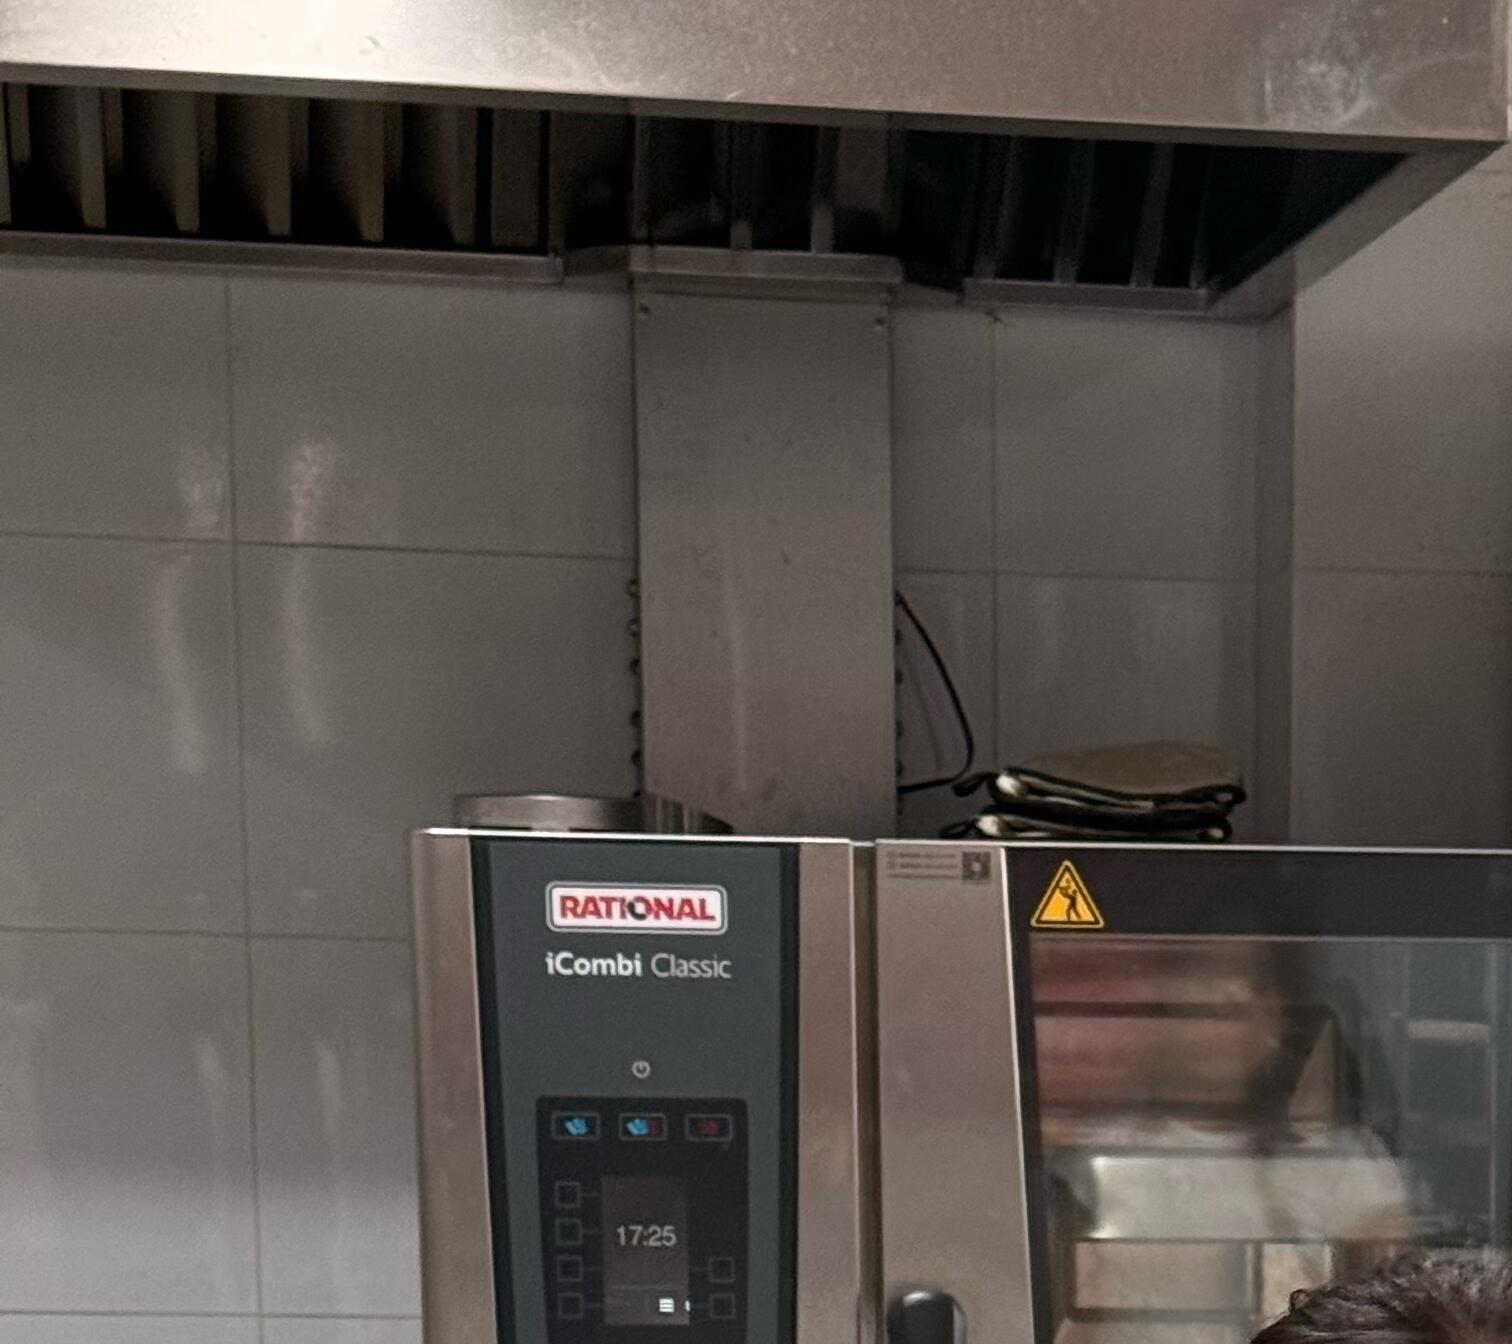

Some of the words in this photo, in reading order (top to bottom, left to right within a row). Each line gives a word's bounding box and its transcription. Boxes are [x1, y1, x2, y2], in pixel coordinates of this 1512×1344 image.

[560, 895, 716, 922] RATIONAL
[545, 952, 642, 977] iCombi
[651, 953, 732, 979] Classic
[616, 1225, 678, 1247] 17:25
